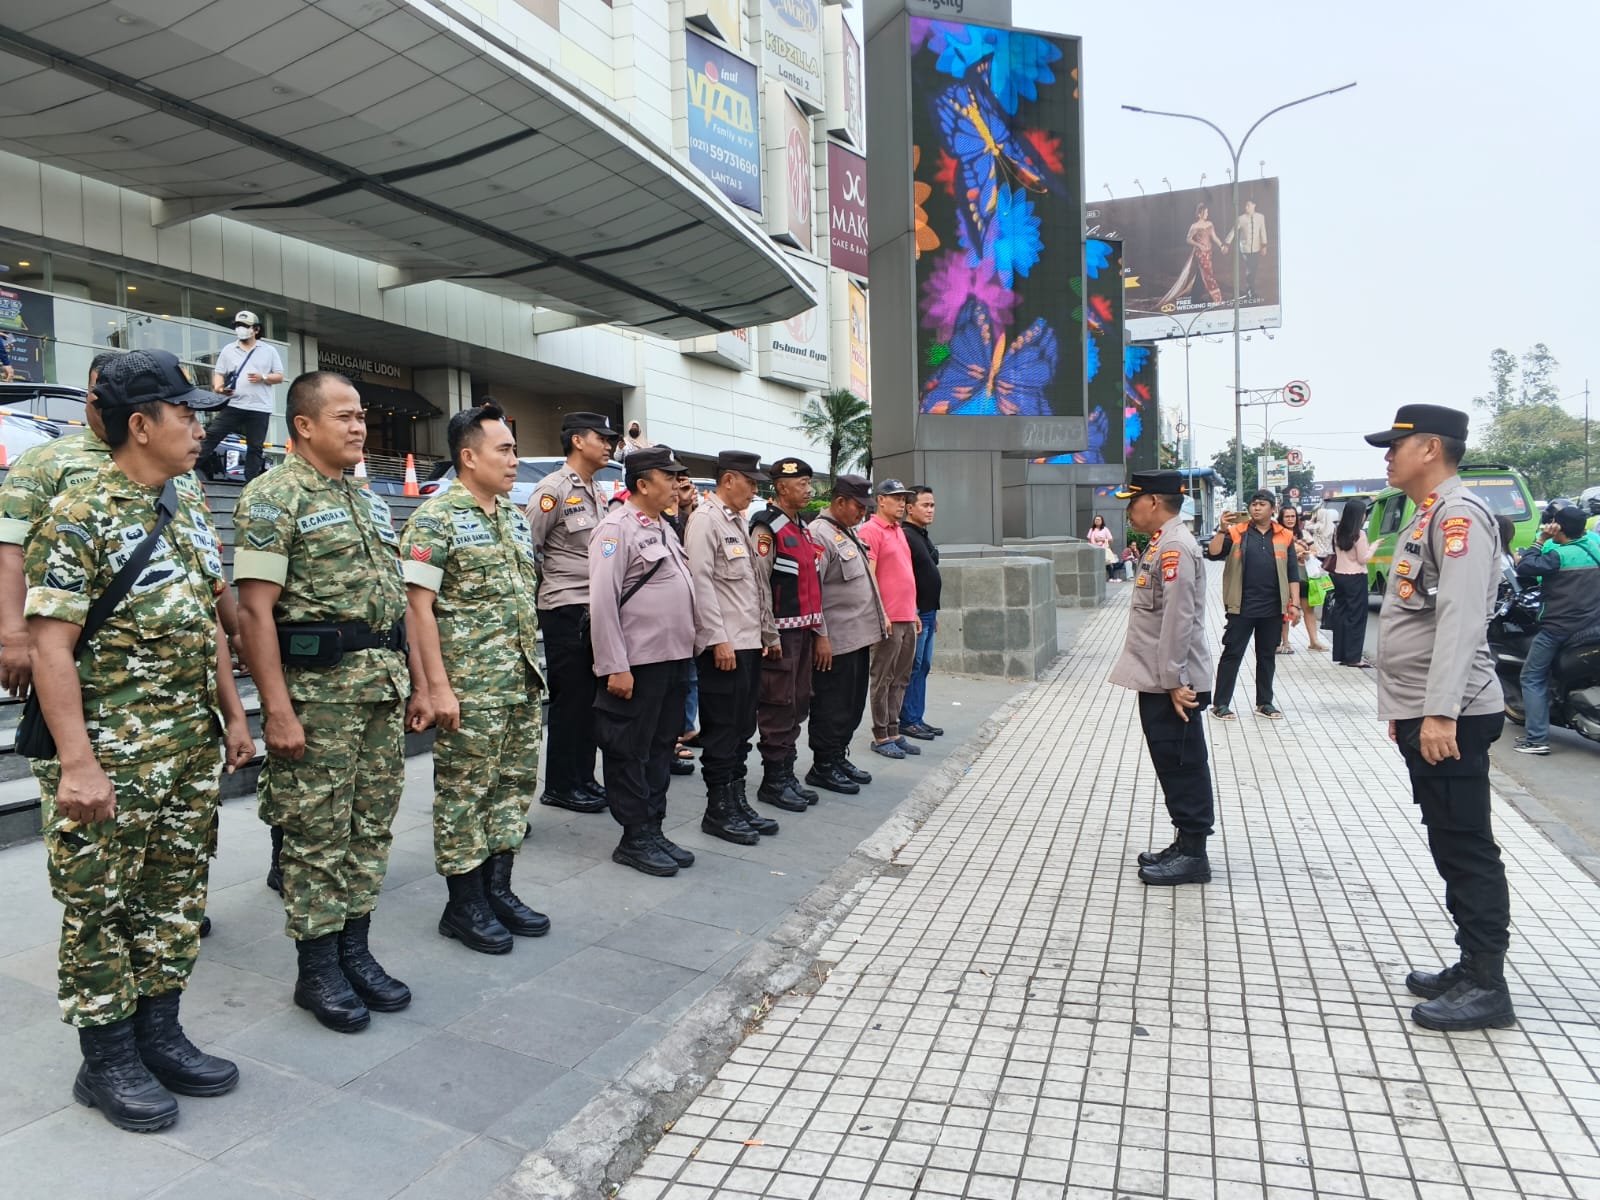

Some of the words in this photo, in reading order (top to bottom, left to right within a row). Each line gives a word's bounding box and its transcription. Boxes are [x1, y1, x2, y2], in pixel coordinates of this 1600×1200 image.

[765, 30, 819, 78] KIDZILLA
[779, 64, 803, 87] Lantai
[805, 79, 810, 91] 2
[710, 145, 758, 177] 59731690
[711, 169, 737, 188] LANTAI
[831, 205, 868, 246] MAK
[832, 237, 849, 250] CAKE
[772, 340, 807, 356] Osbond
[319, 350, 373, 372] MARUGAME
[374, 362, 400, 377] UDON
[1289, 385, 1304, 403] S
